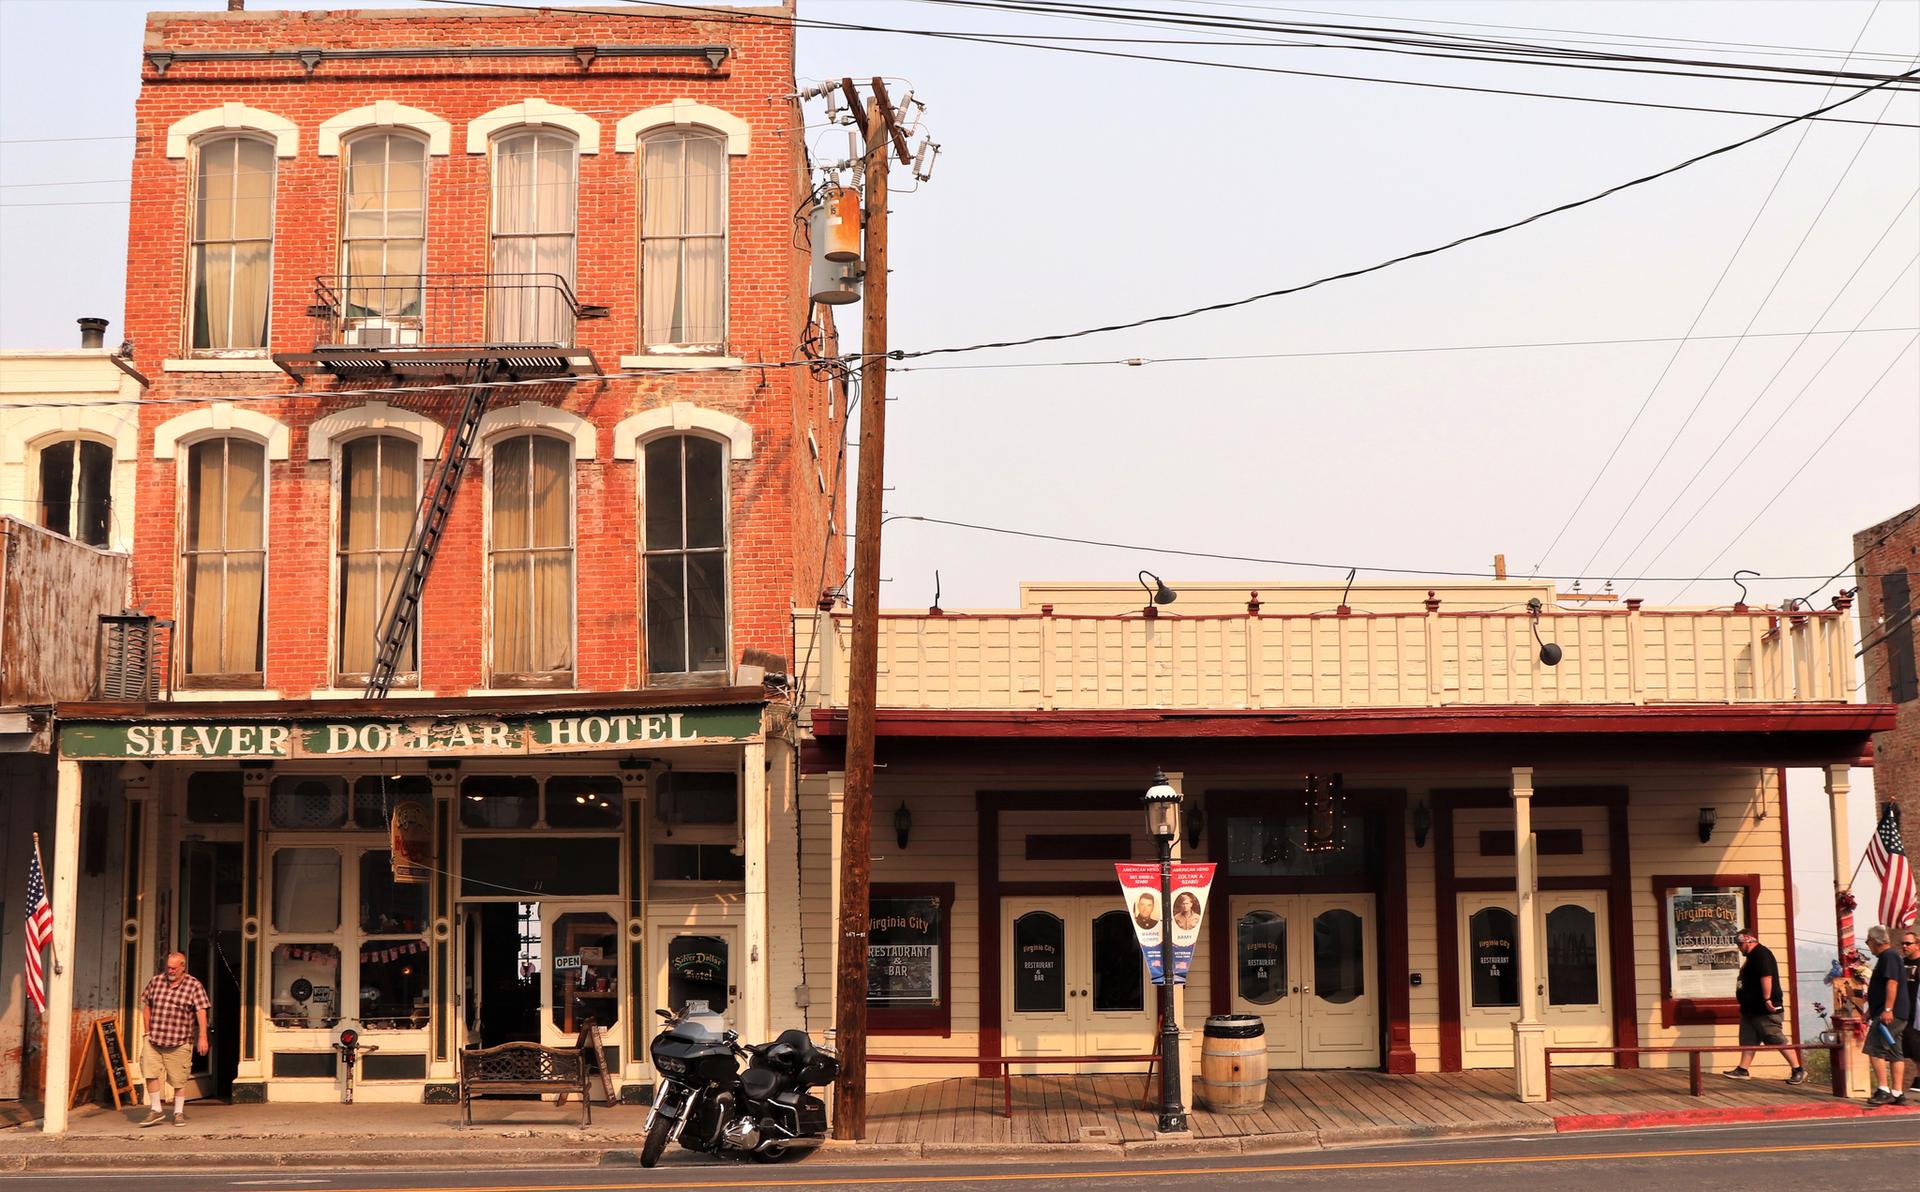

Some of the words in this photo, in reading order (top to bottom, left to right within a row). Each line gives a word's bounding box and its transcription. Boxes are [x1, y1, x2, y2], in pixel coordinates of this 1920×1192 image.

[126, 725, 289, 755] SILVER
[548, 713, 697, 745] HOTEL
[1675, 905, 1713, 922] Virginia
[1716, 906, 1737, 922] City
[909, 916, 929, 934] City
[1677, 935, 1736, 947] RESTAURANT
[868, 945, 929, 958] RESTAURANT
[556, 957, 580, 967] OPEN
[673, 954, 696, 969] Silver
[695, 952, 722, 967] Dollar
[1247, 959, 1276, 967] RESTAURANT
[1480, 956, 1509, 964] RESTAURANT
[1697, 952, 1717, 965] BAR
[888, 965, 908, 976] BAR
[1024, 961, 1054, 969] RESTAURANT
[1034, 974, 1045, 982] BAR
[1257, 971, 1268, 979] BAR
[1490, 969, 1501, 977] BAR
